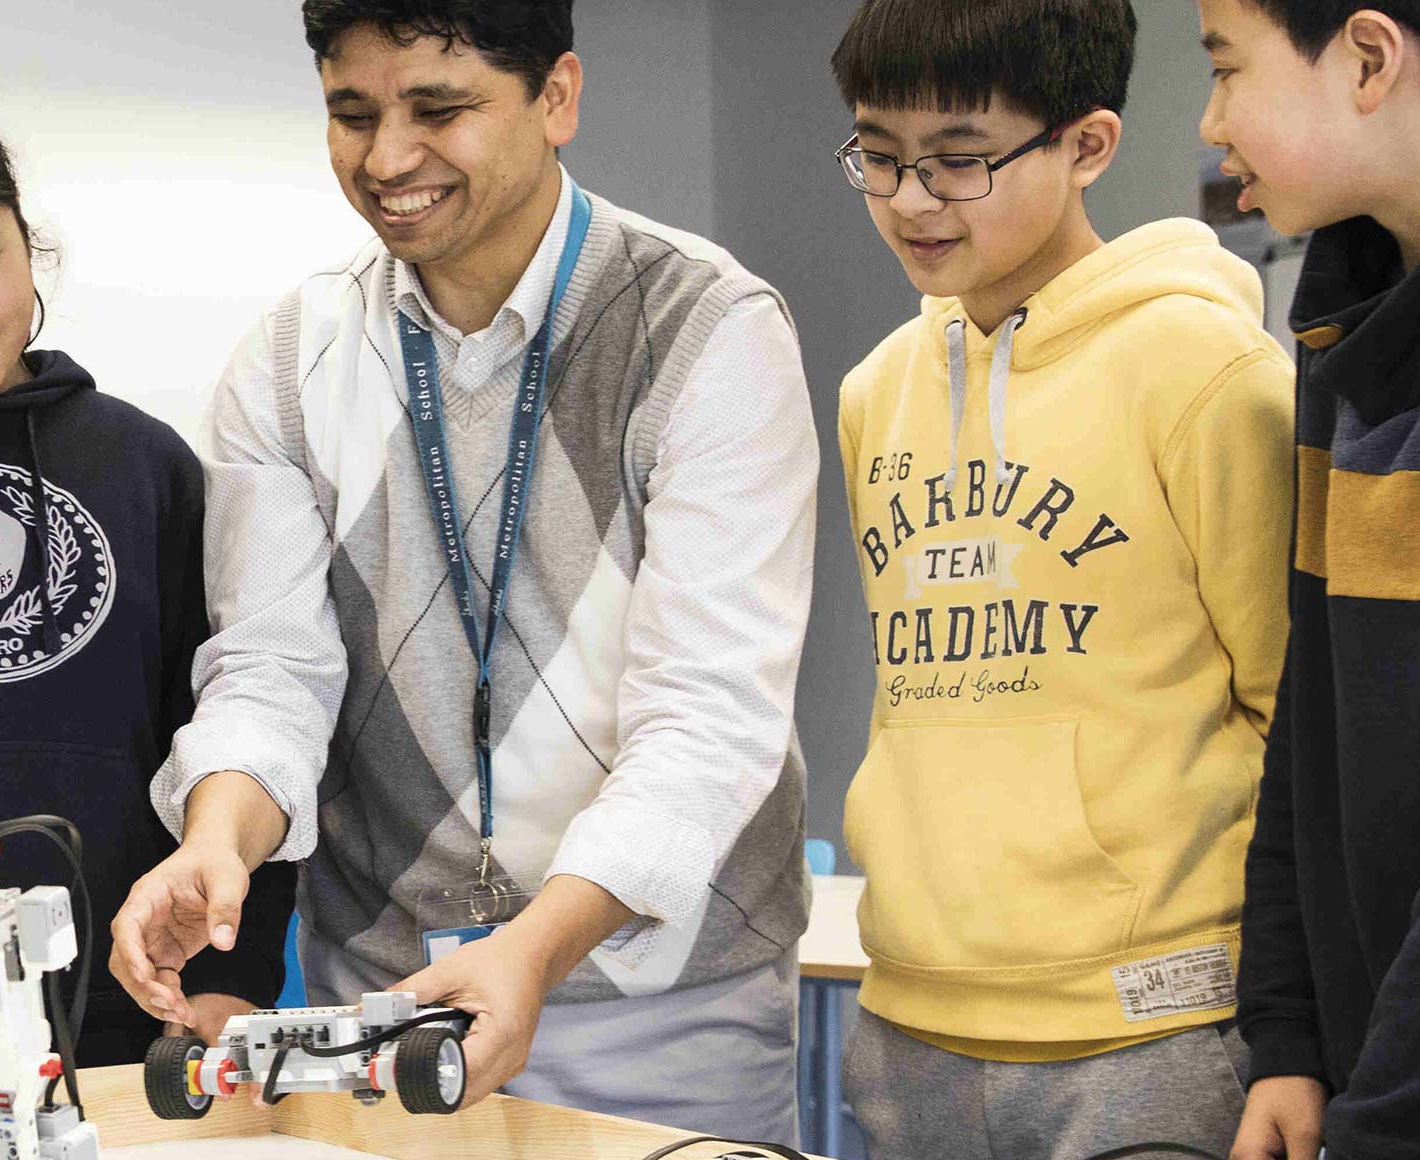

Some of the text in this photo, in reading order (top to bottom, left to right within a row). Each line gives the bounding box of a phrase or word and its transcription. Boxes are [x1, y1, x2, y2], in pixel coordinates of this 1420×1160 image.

[412, 361, 434, 421] School
[499, 351, 541, 559] Metropolitan School
[868, 452, 914, 484] B-36
[430, 446, 461, 563] Metropolitan
[862, 459, 1130, 578] BARBURY
[925, 541, 997, 579] TEAM
[885, 665, 1043, 707] Graded Goods
[1144, 969, 1164, 991] 34
